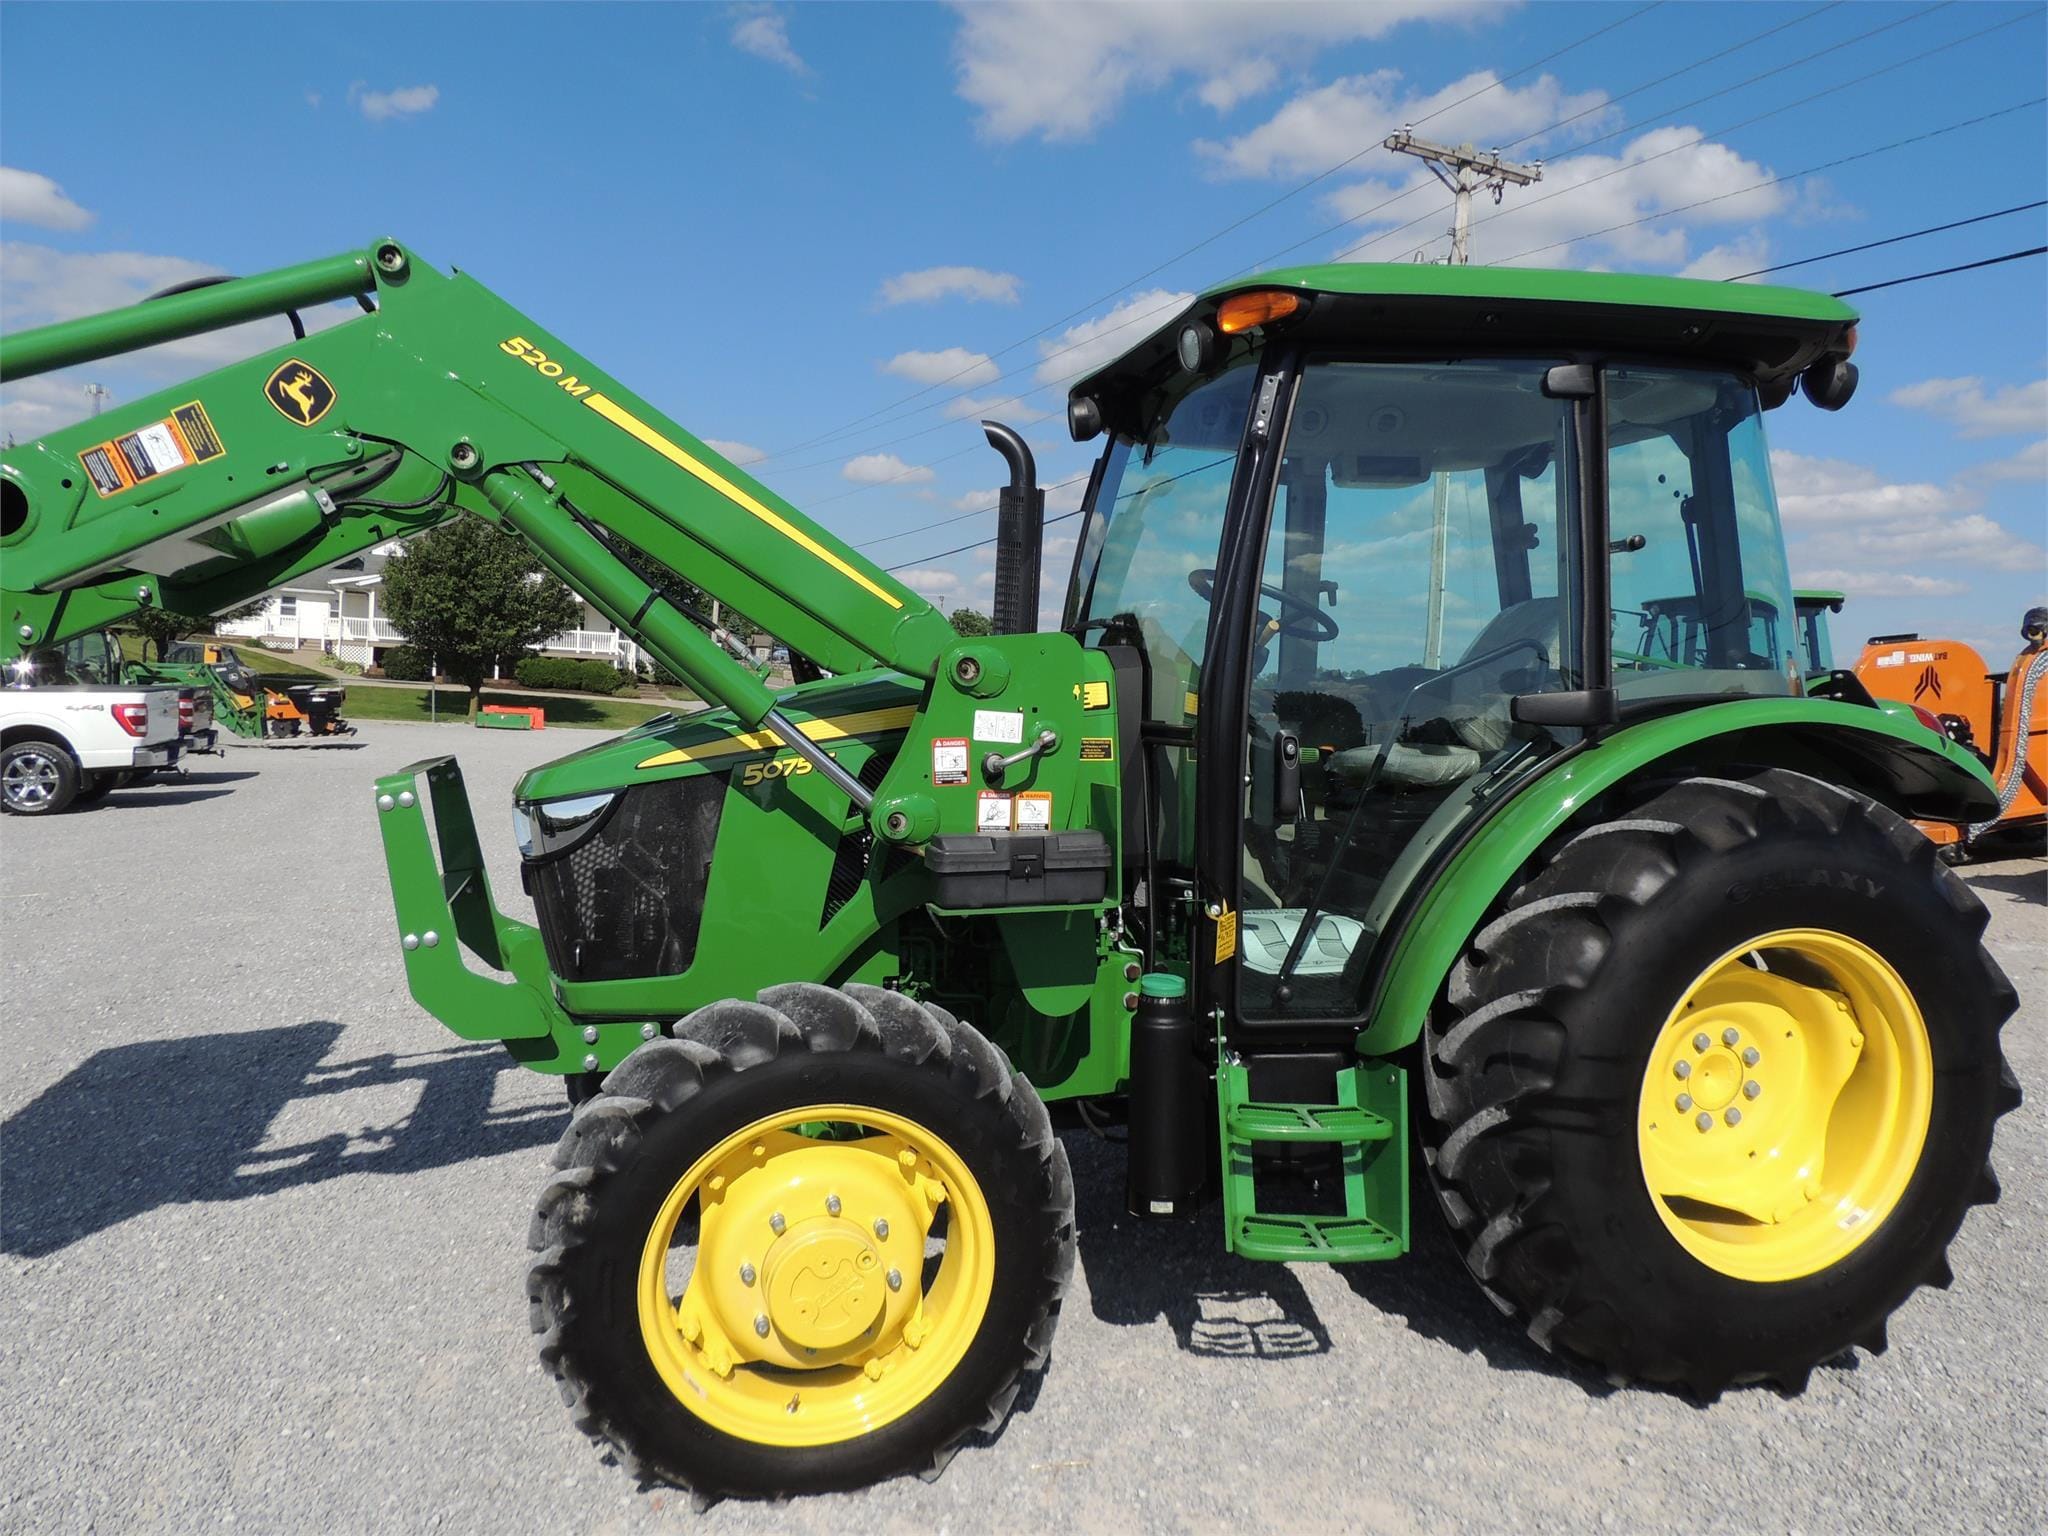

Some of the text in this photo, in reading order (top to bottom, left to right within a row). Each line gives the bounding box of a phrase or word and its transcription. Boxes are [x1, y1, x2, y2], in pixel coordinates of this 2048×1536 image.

[498, 335, 592, 398] 520 M
[742, 752, 837, 787] 5075
